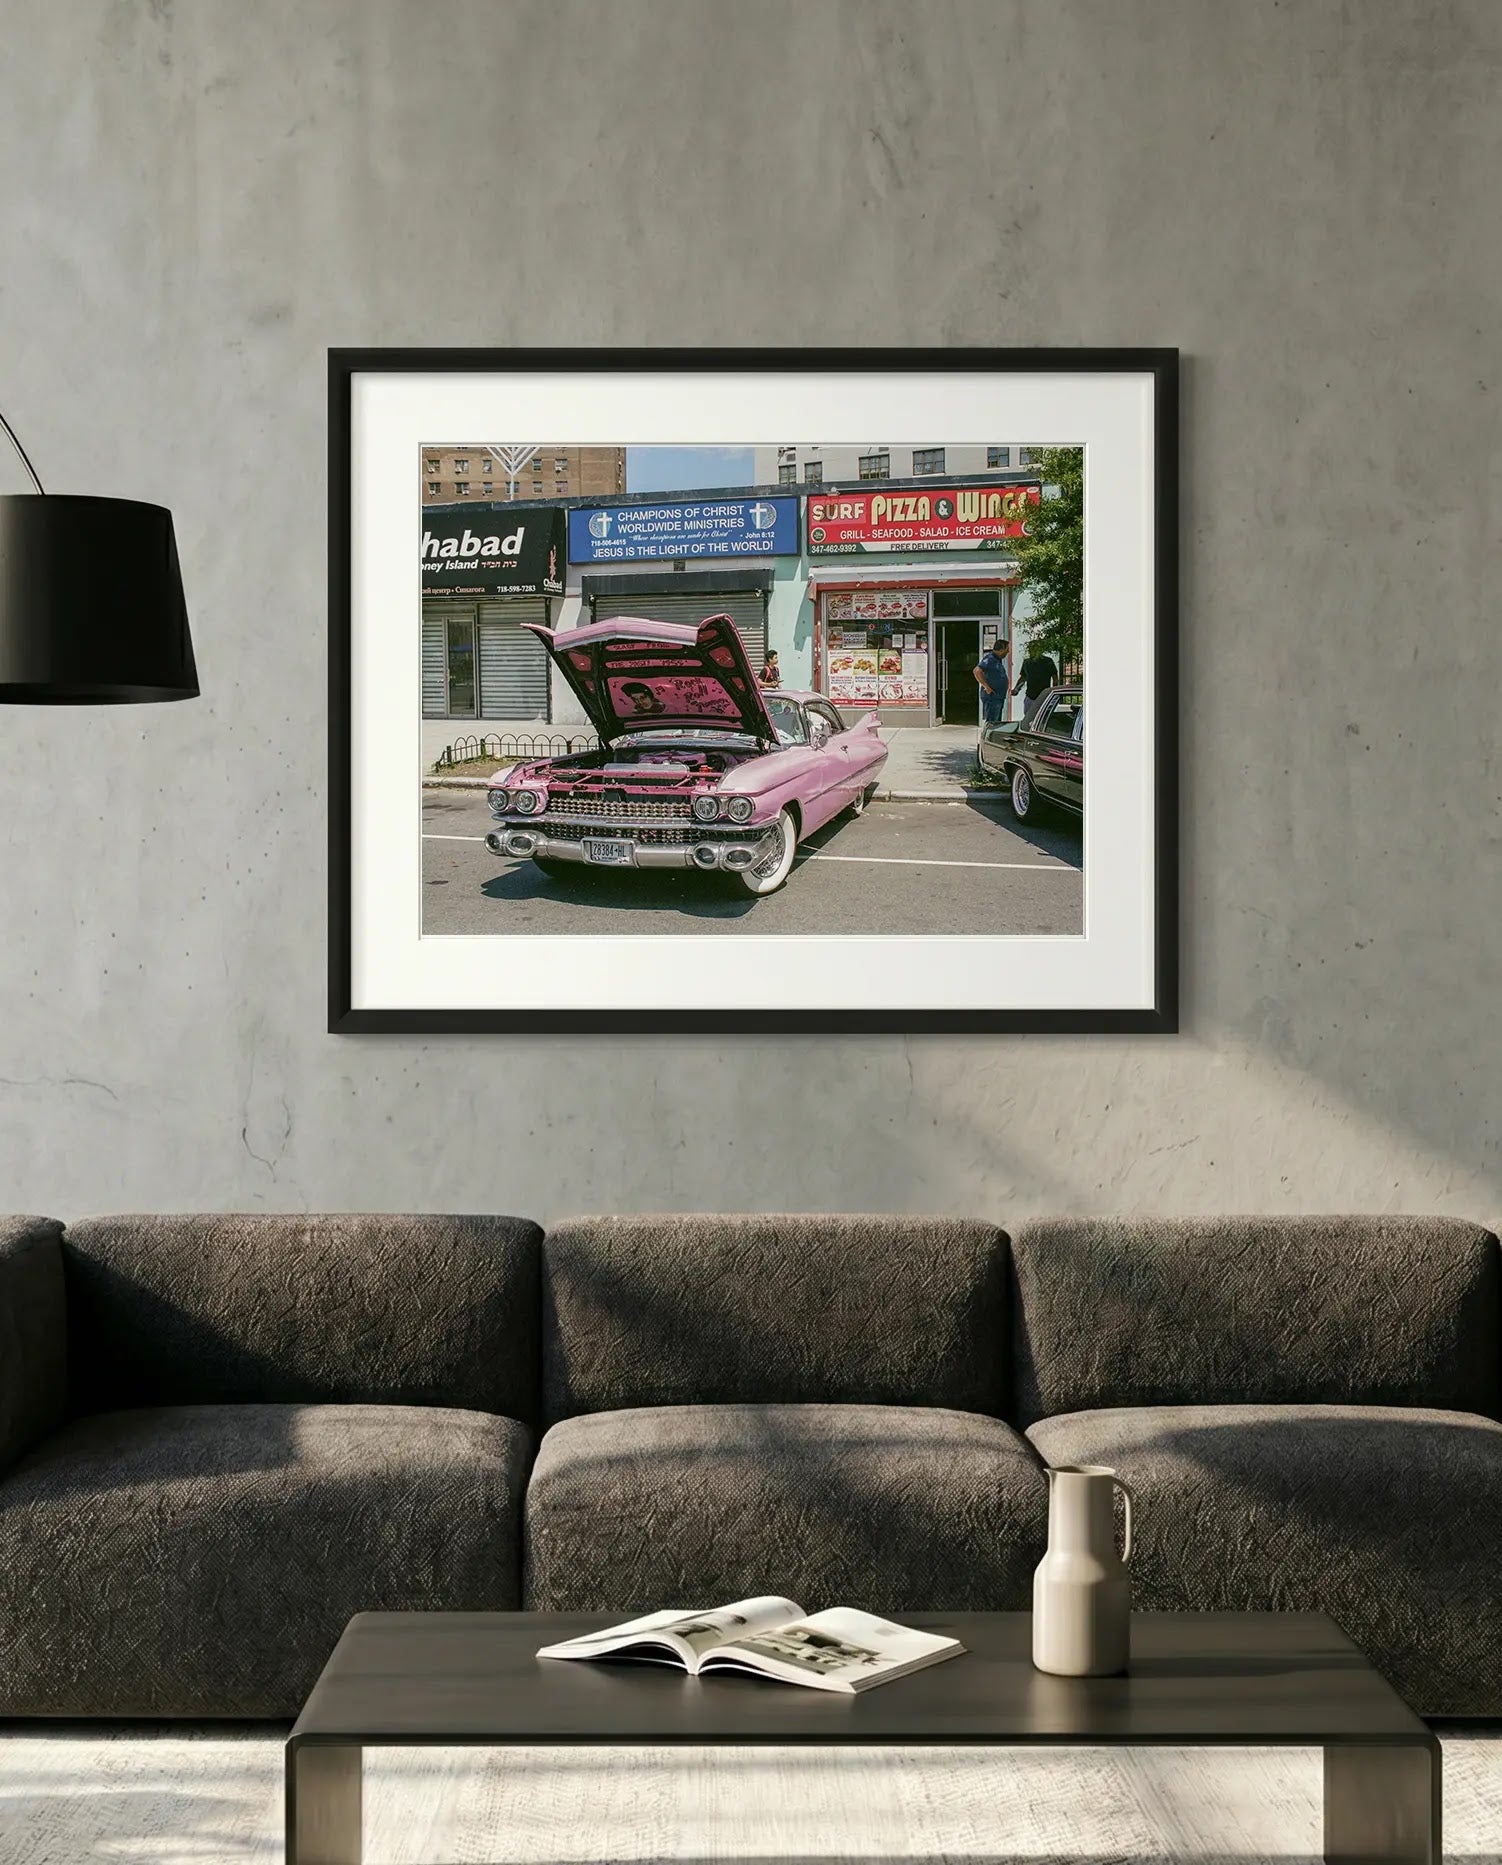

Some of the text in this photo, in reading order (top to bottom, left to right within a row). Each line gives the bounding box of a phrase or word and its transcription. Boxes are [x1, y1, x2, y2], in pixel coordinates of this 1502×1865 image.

[617, 505, 745, 522] CHAMPIONS OF CHRIST
[812, 502, 865, 521] SURF
[871, 495, 931, 525] PIZZA
[938, 499, 949, 516] &
[617, 518, 745, 534] WORLDWIDE MINISTRIES
[840, 530, 866, 540] GRILL
[871, 528, 914, 539] SEAFOOD
[919, 526, 949, 537] SALAD
[956, 526, 971, 536] ICE
[972, 525, 1006, 535] CREAM
[593, 540, 773, 558] JESUS IS THE LIGHT OF THE WORLD!
[811, 544, 857, 554] 347-462-9392
[890, 542, 950, 551] FREE DELIVERY
[445, 559, 479, 570] Island
[496, 585, 536, 593] 718-598-7283
